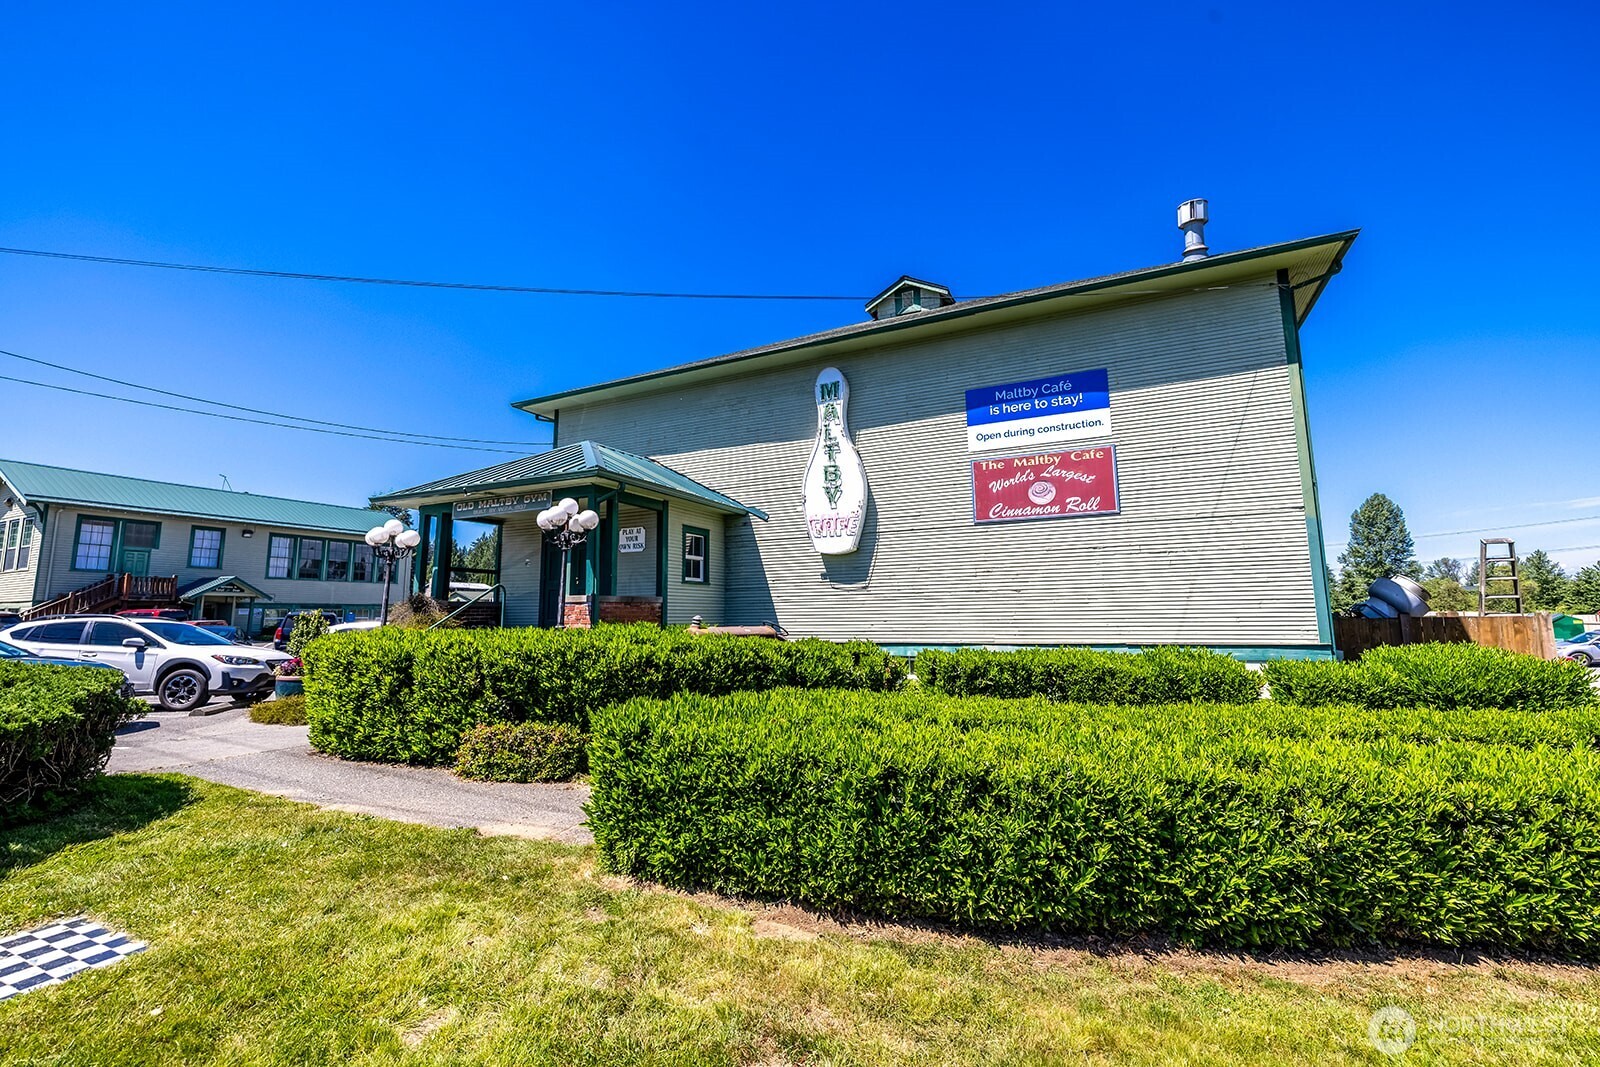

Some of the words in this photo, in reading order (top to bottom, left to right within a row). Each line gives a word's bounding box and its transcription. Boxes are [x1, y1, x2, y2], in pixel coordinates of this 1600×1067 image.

[995, 386, 1039, 401] Maltby
[1041, 380, 1073, 395] Café
[989, 405, 1000, 416] is
[1002, 402, 1031, 415] here
[1034, 398, 1048, 409] to
[1051, 392, 1084, 407] stay!
[976, 432, 1002, 443] Open
[1003, 427, 1035, 439] during
[1037, 418, 1104, 434] construction.
[820, 380, 843, 509] MALTBY
[980, 460, 1005, 472] The
[1013, 454, 1062, 468] Maltby
[1070, 449, 1104, 462] Cafe
[1040, 465, 1096, 484] Largest
[456, 502, 474, 512] OLD
[478, 496, 519, 508] MALTBY
[523, 492, 547, 504] GYM
[988, 503, 1061, 519] Cinnamon
[1065, 496, 1100, 513] Roll
[625, 535, 639, 543] YOUR
[632, 542, 645, 550] RISK
